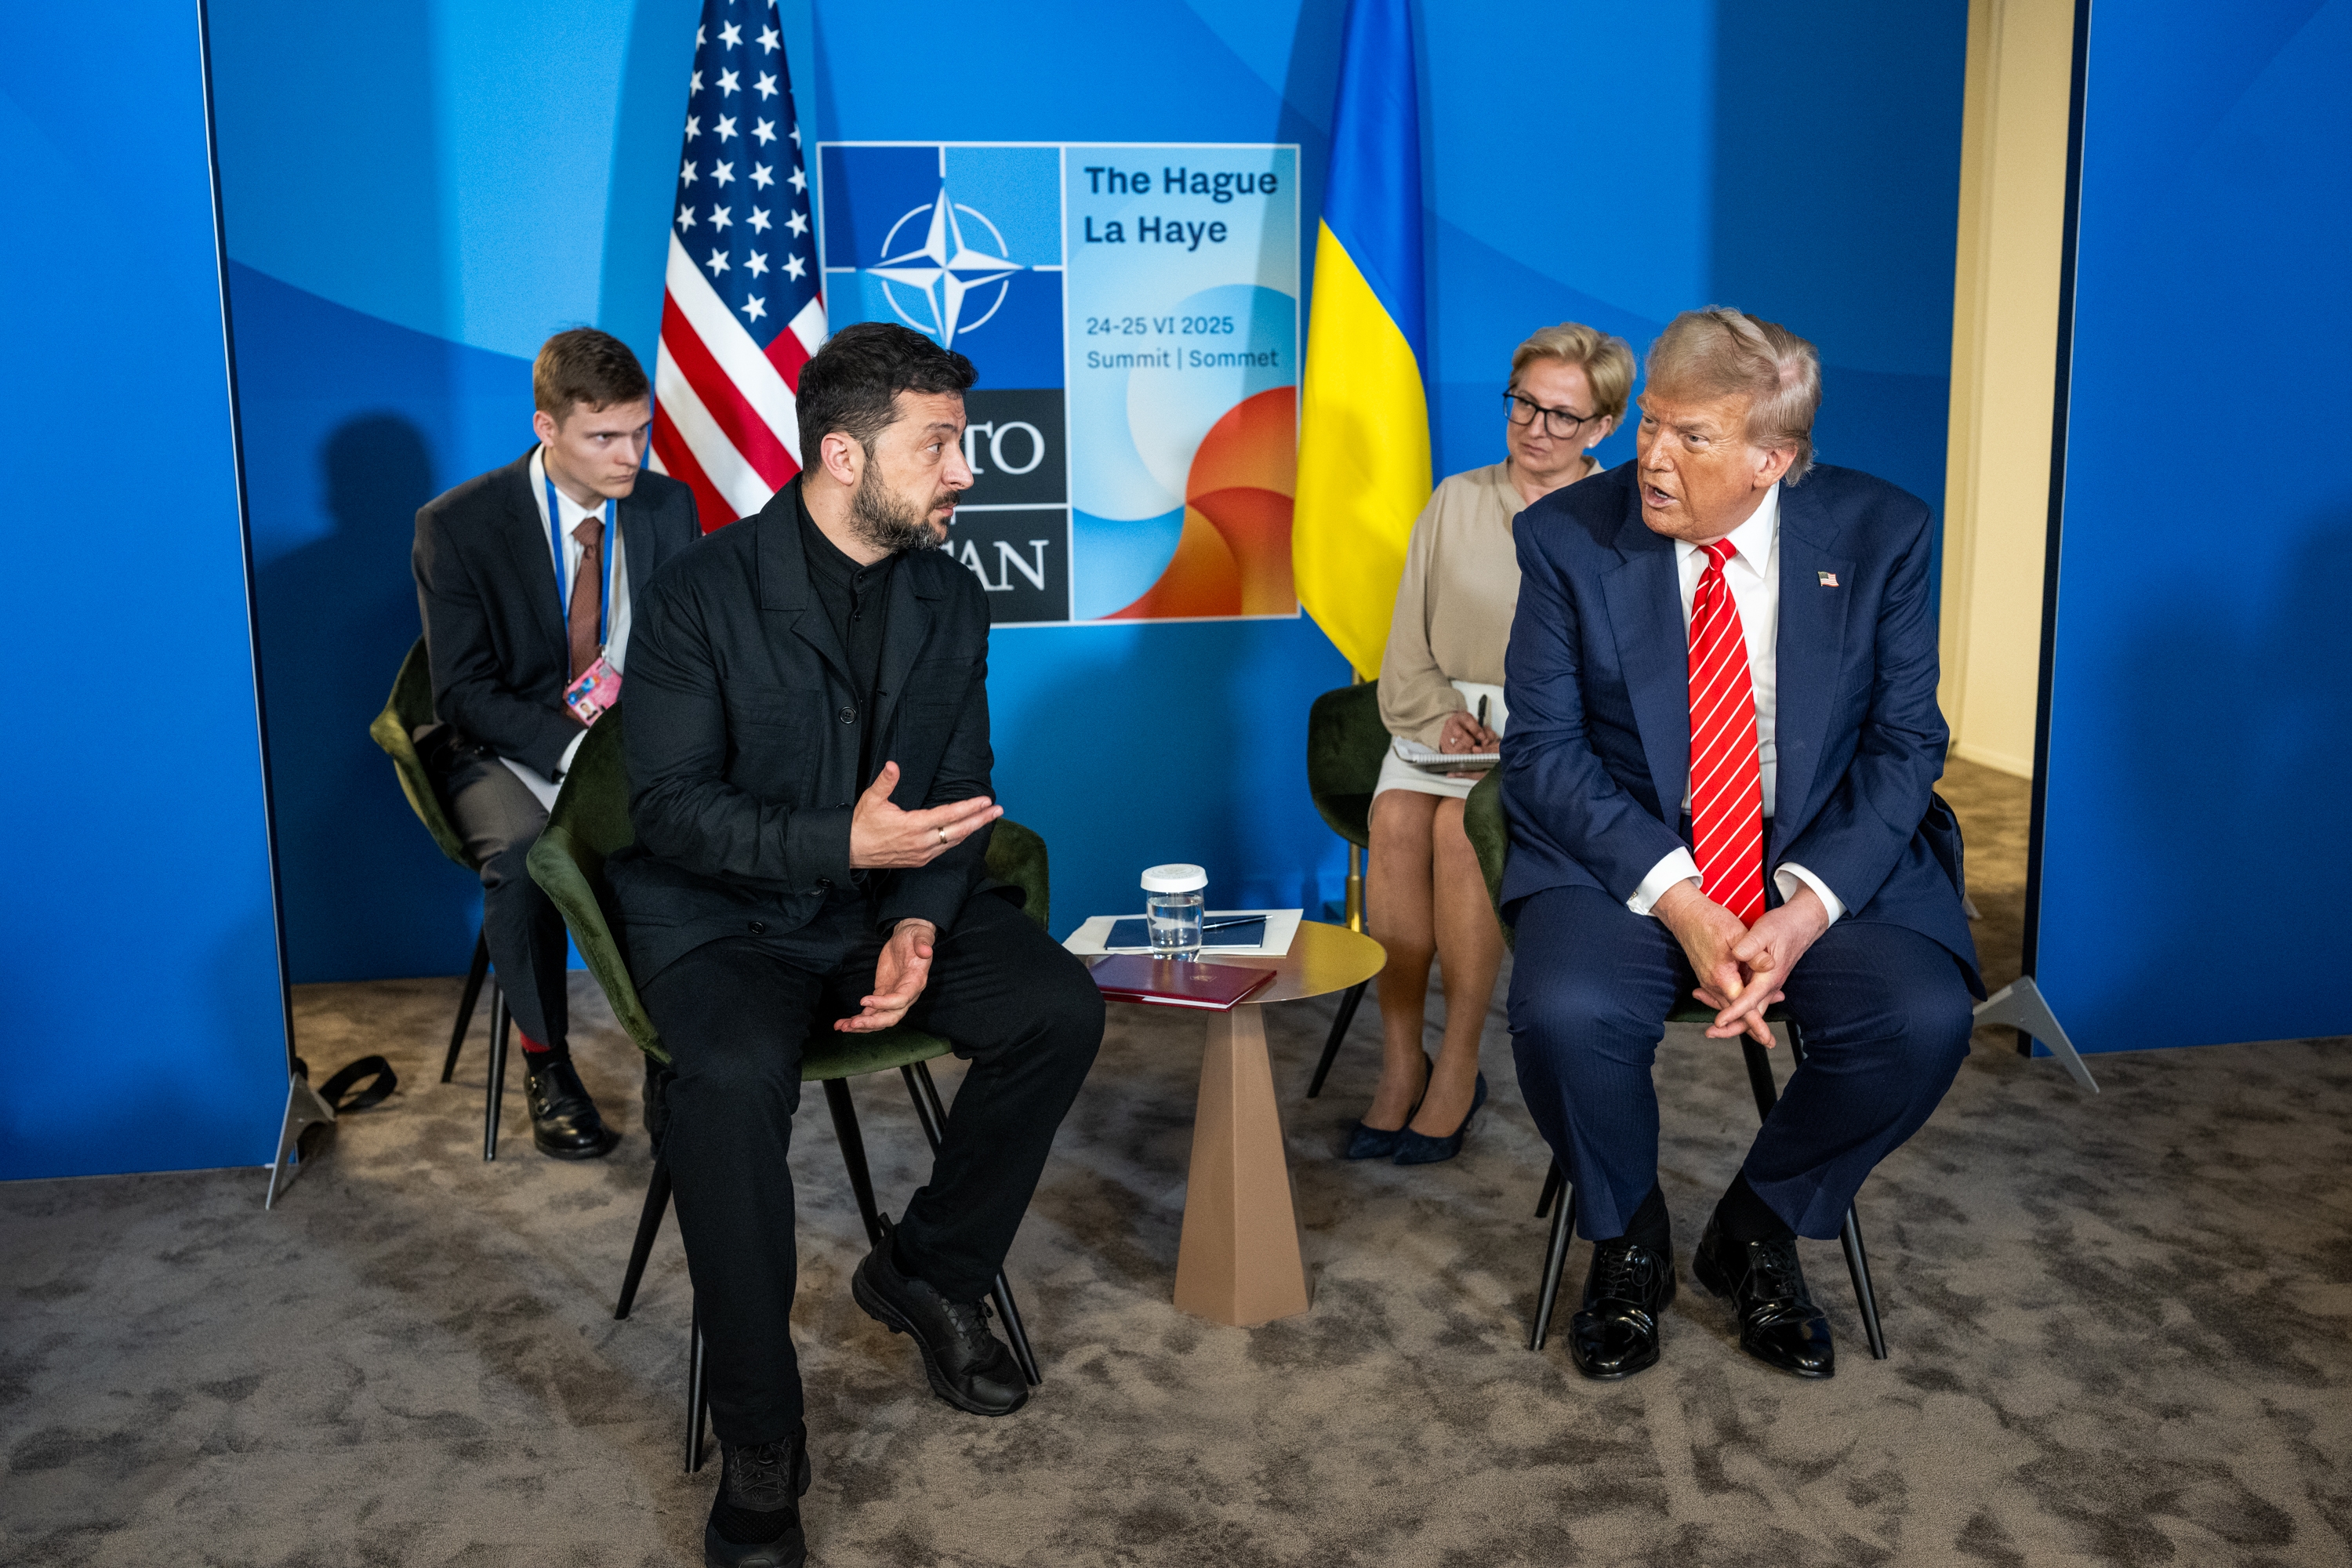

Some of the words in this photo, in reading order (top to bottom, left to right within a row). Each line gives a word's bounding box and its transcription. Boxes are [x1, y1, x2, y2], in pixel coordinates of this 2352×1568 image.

[1083, 165, 1152, 195] The
[1163, 165, 1279, 205] Hague
[1084, 215, 1127, 244] La
[1138, 216, 1229, 252] Haye
[1086, 316, 1149, 336] 24-25
[1152, 317, 1175, 335] VI
[1181, 315, 1236, 335] 2025
[1087, 348, 1171, 369] Summit
[1189, 348, 1279, 368] Sommet
[964, 420, 1046, 475] TO
[941, 539, 1050, 592] AN
